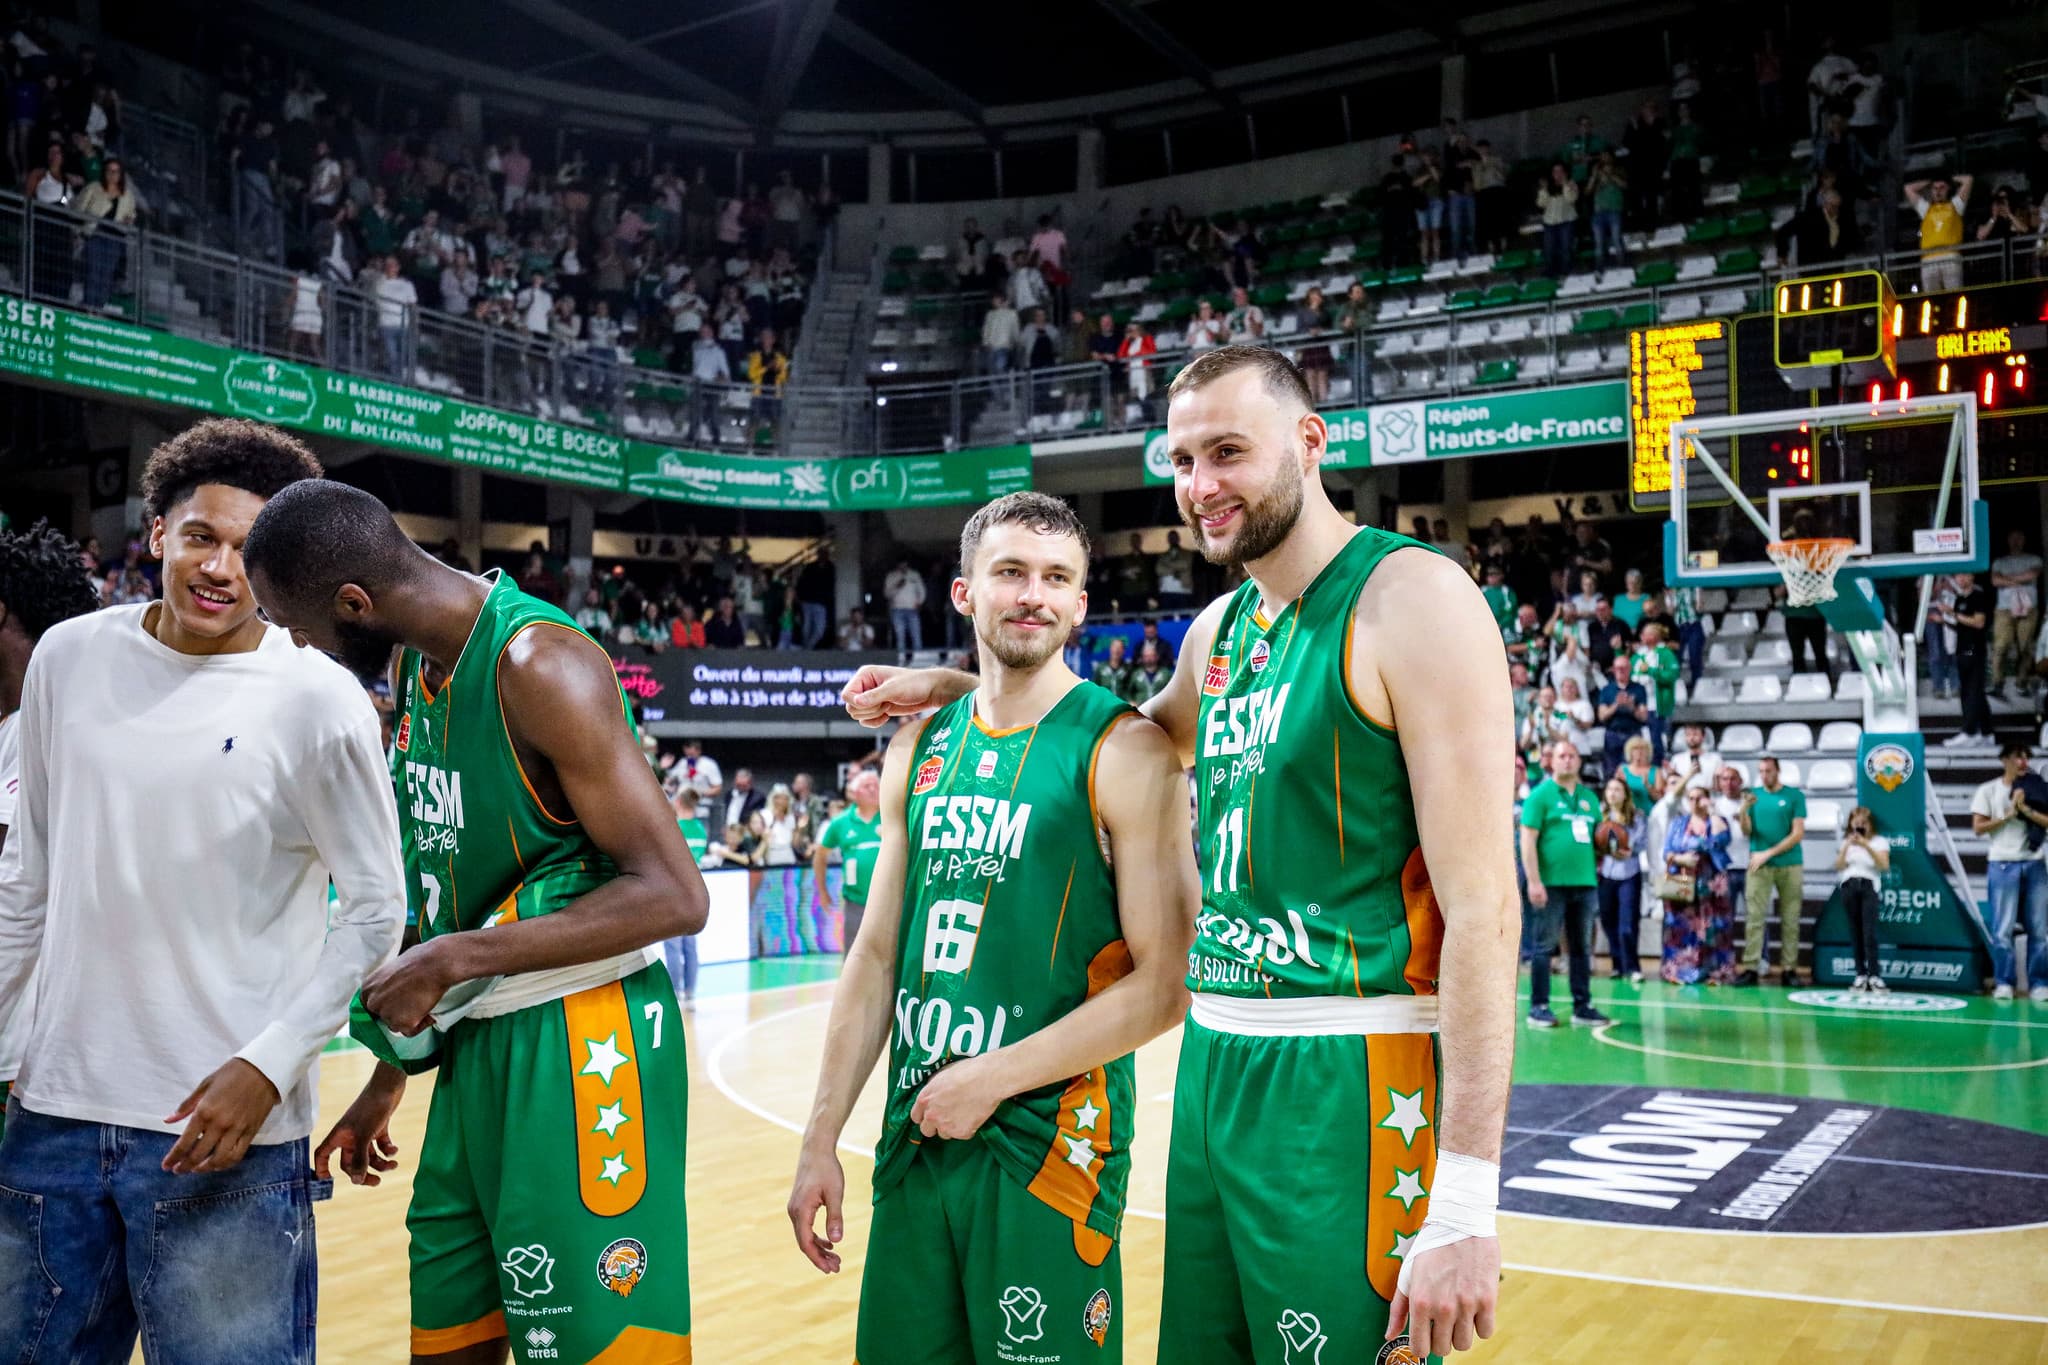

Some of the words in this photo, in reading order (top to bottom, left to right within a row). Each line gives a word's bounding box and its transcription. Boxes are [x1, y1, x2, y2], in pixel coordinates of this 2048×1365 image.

[0, 297, 55, 331] SER
[1937, 328, 2011, 359] ORLEANS
[326, 376, 344, 394] LE
[349, 381, 443, 415] BARBERSHOP
[355, 401, 415, 427] VINTAGE
[1427, 405, 1490, 427] Région
[323, 413, 347, 431] DU
[351, 420, 444, 451] BOULONNAIS
[454, 408, 529, 447] Joffrey
[534, 424, 557, 448] DE
[562, 431, 620, 460] BOECK
[1428, 416, 1624, 450] Hauts-de-France
[851, 459, 888, 493] pfi
[693, 664, 740, 683] Ouvert
[741, 666, 758, 683] du
[762, 666, 802, 683] mardi
[804, 669, 822, 683] au
[690, 690, 708, 706] de
[710, 689, 729, 706] 8h
[730, 689, 740, 706] à
[742, 689, 768, 708] 13h
[770, 691, 785, 706] et
[788, 690, 806, 706] de
[808, 690, 835, 707] 15h
[1203, 682, 1291, 758] ESSM
[921, 795, 1032, 860] ESSM
[1213, 807, 1244, 894] 11
[420, 871, 441, 928] 7
[1881, 889, 1941, 909] RECH
[923, 899, 985, 975] 6
[644, 1000, 665, 1049] 7
[1504, 1091, 1799, 1211] MOWI
[506, 1305, 573, 1317] Hauts-de-France
[527, 1348, 559, 1359] errea
